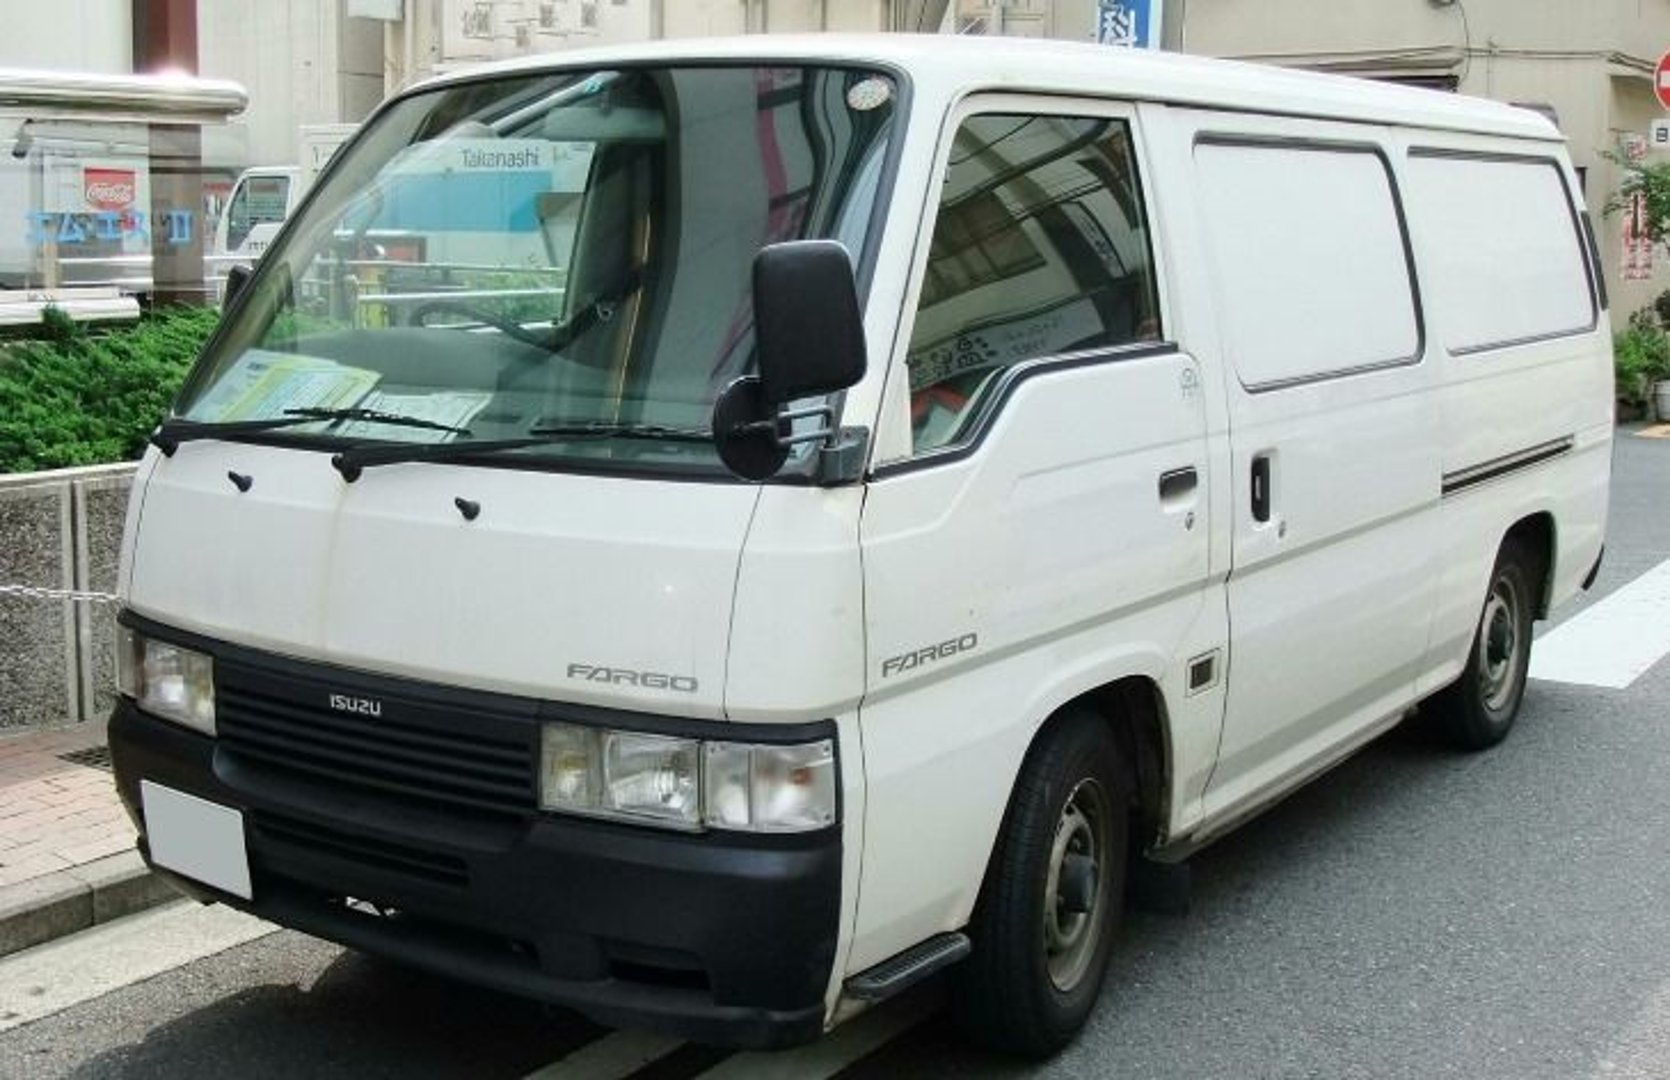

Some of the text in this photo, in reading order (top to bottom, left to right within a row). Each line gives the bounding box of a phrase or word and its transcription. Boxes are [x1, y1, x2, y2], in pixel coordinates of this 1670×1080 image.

[1101, 4, 1137, 48] 科
[462, 147, 540, 168] Takanashi
[881, 632, 978, 678] FARGO
[566, 662, 699, 693] FARGO
[329, 693, 382, 718] ISUZU
